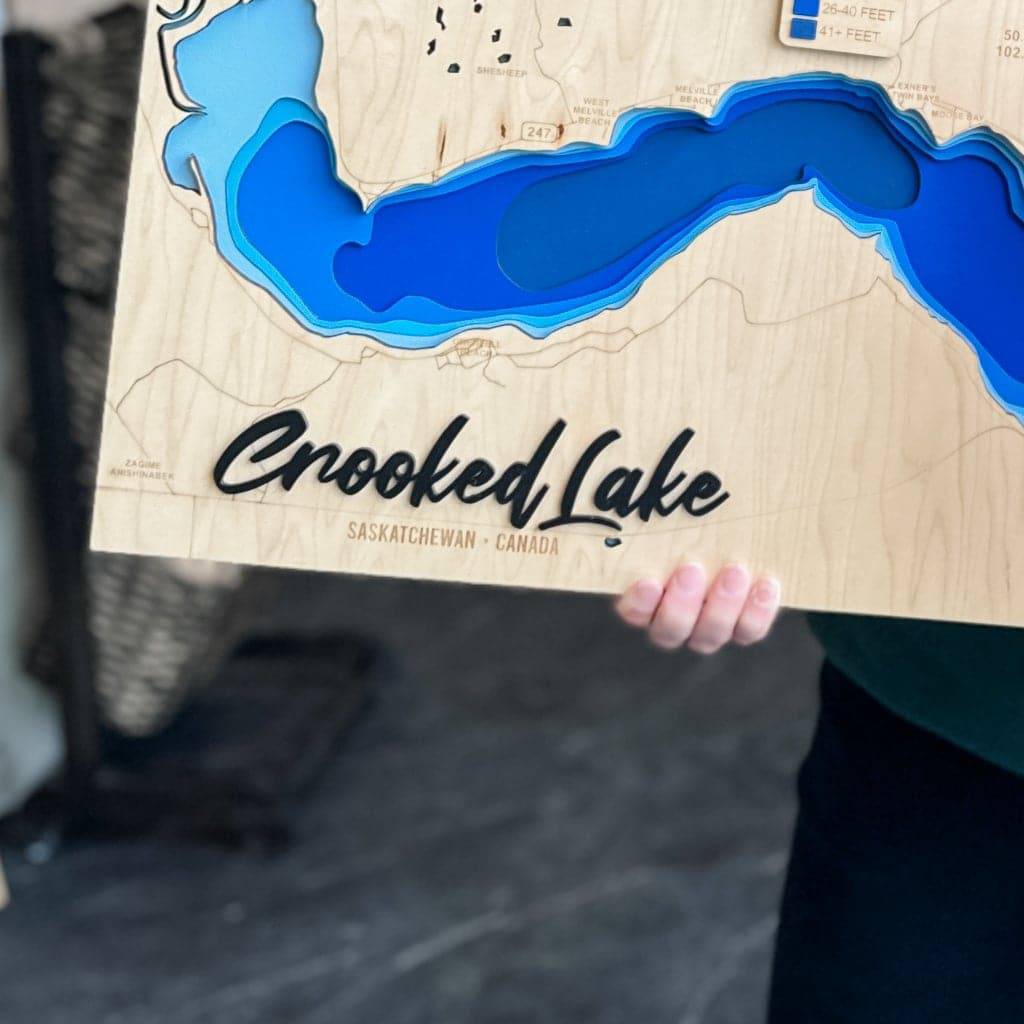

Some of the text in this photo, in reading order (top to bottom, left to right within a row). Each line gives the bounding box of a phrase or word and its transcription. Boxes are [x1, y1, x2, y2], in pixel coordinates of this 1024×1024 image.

[823, 2, 896, 22] 26-40 FEET
[819, 25, 881, 43] 41+ FEET
[583, 97, 610, 107] WEST
[680, 95, 712, 105] BEACH
[573, 106, 617, 117] MELVILLE
[578, 116, 611, 127] BEACH
[527, 126, 552, 139] 247
[211, 408, 731, 532] Crooked Lake
[346, 520, 560, 556] SASKATCHEWAN CANADA
